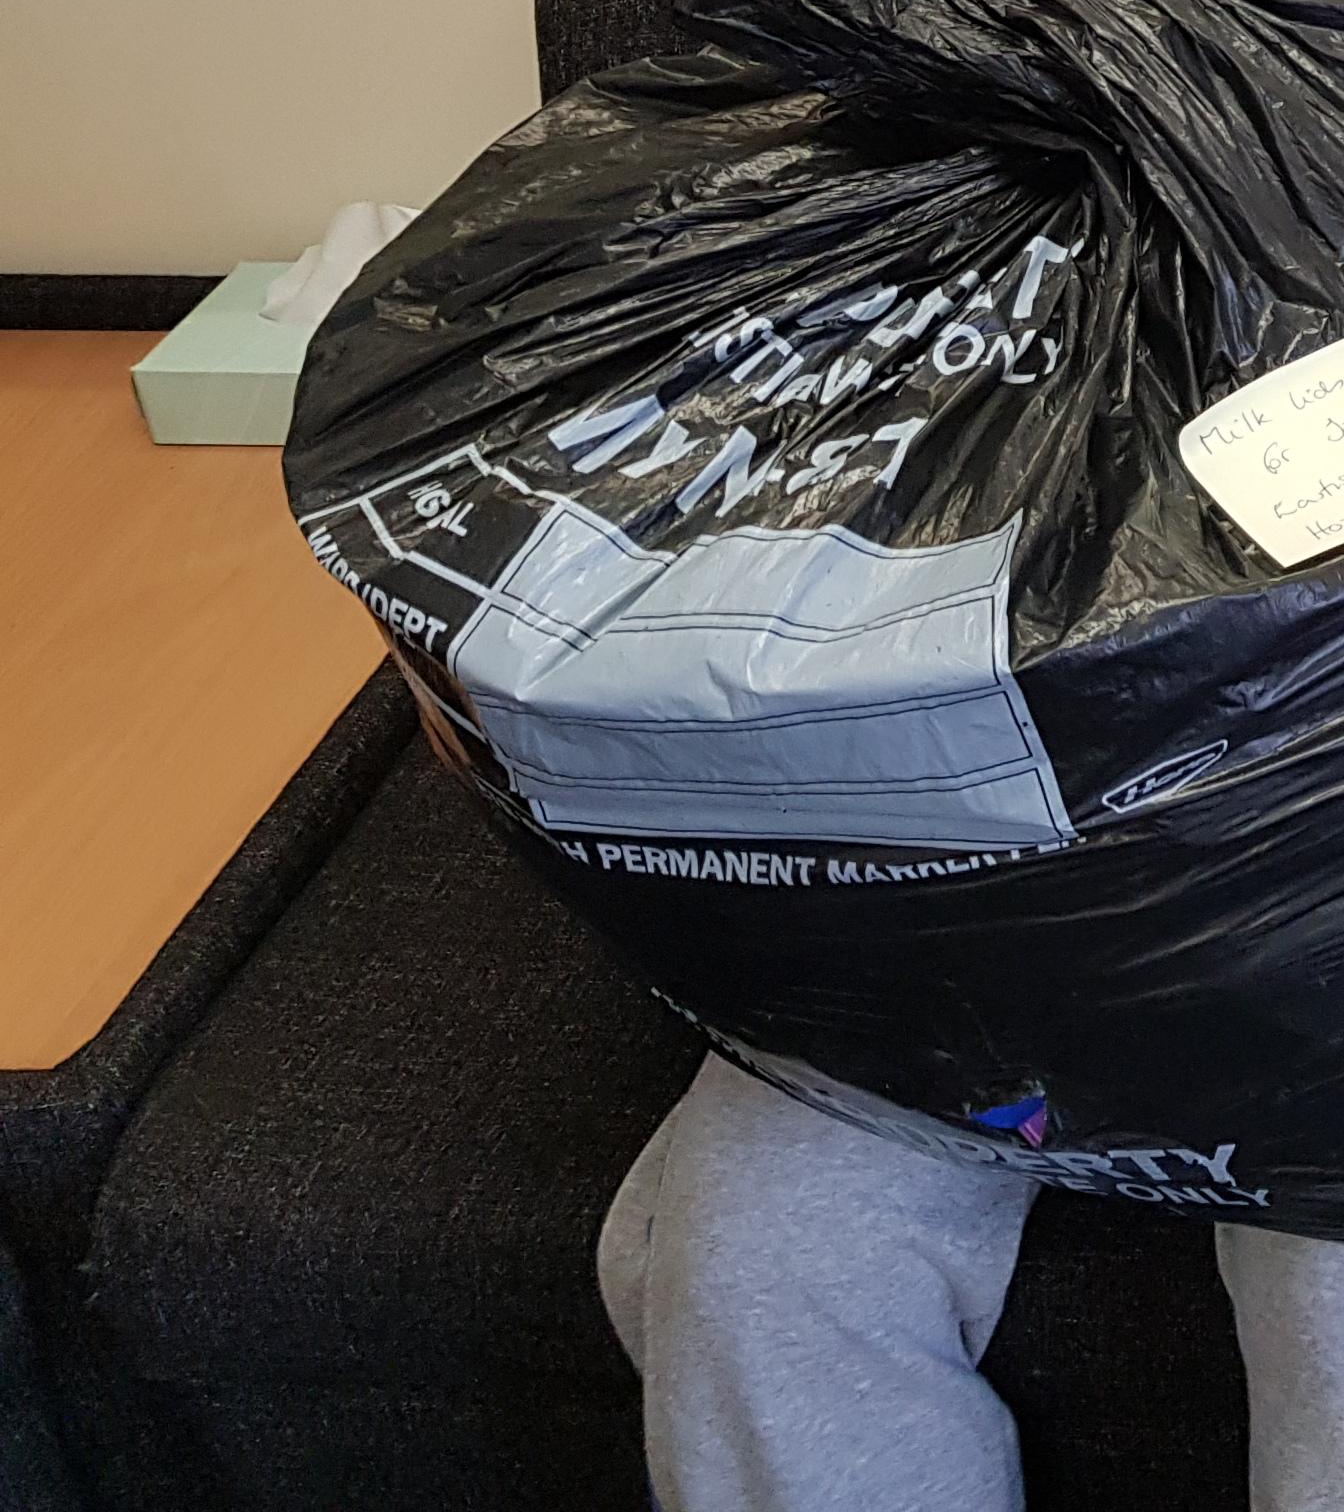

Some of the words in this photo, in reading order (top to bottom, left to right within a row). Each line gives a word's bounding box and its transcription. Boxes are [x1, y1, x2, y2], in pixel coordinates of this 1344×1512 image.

[1199, 409, 1272, 455] Milk
[597, 842, 816, 887] PERMANENT
[1115, 1182, 1272, 1208] ONLY
